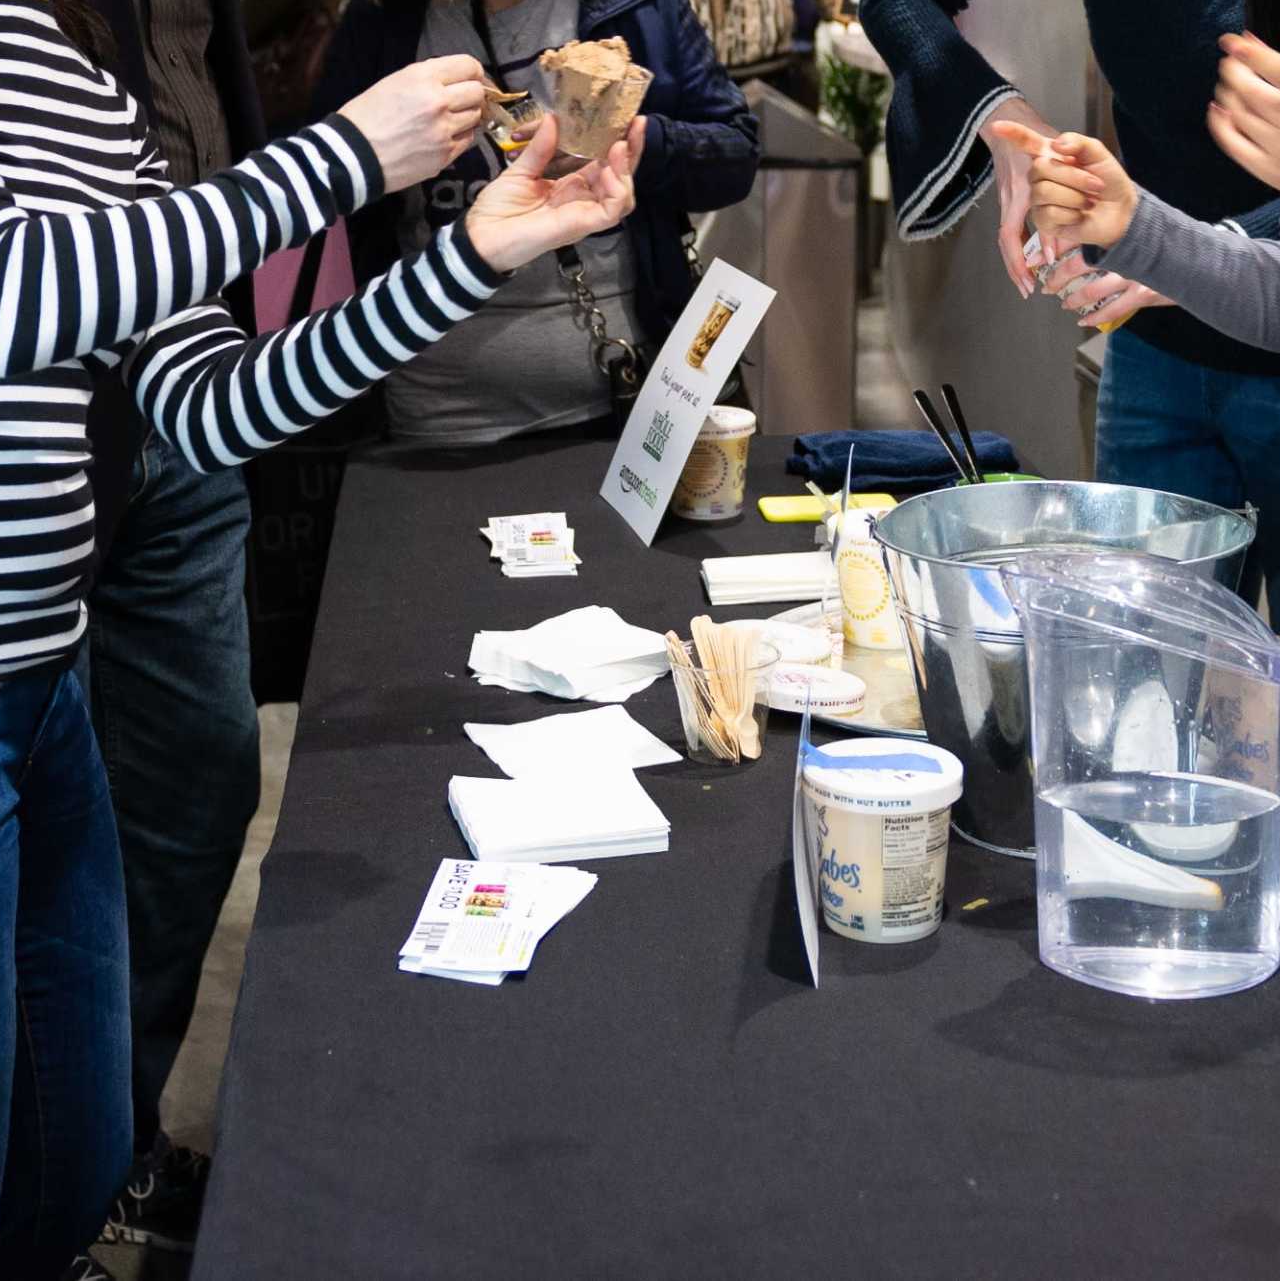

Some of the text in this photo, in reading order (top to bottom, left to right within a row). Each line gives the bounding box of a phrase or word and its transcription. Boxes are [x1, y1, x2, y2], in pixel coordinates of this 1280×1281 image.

[646, 427, 669, 454] FOODS
[833, 793, 854, 805] WITH
[856, 799, 874, 807] NUT
[877, 799, 912, 807] BUTTER
[884, 815, 924, 824] Nutrition
[448, 863, 473, 885] SAVE
